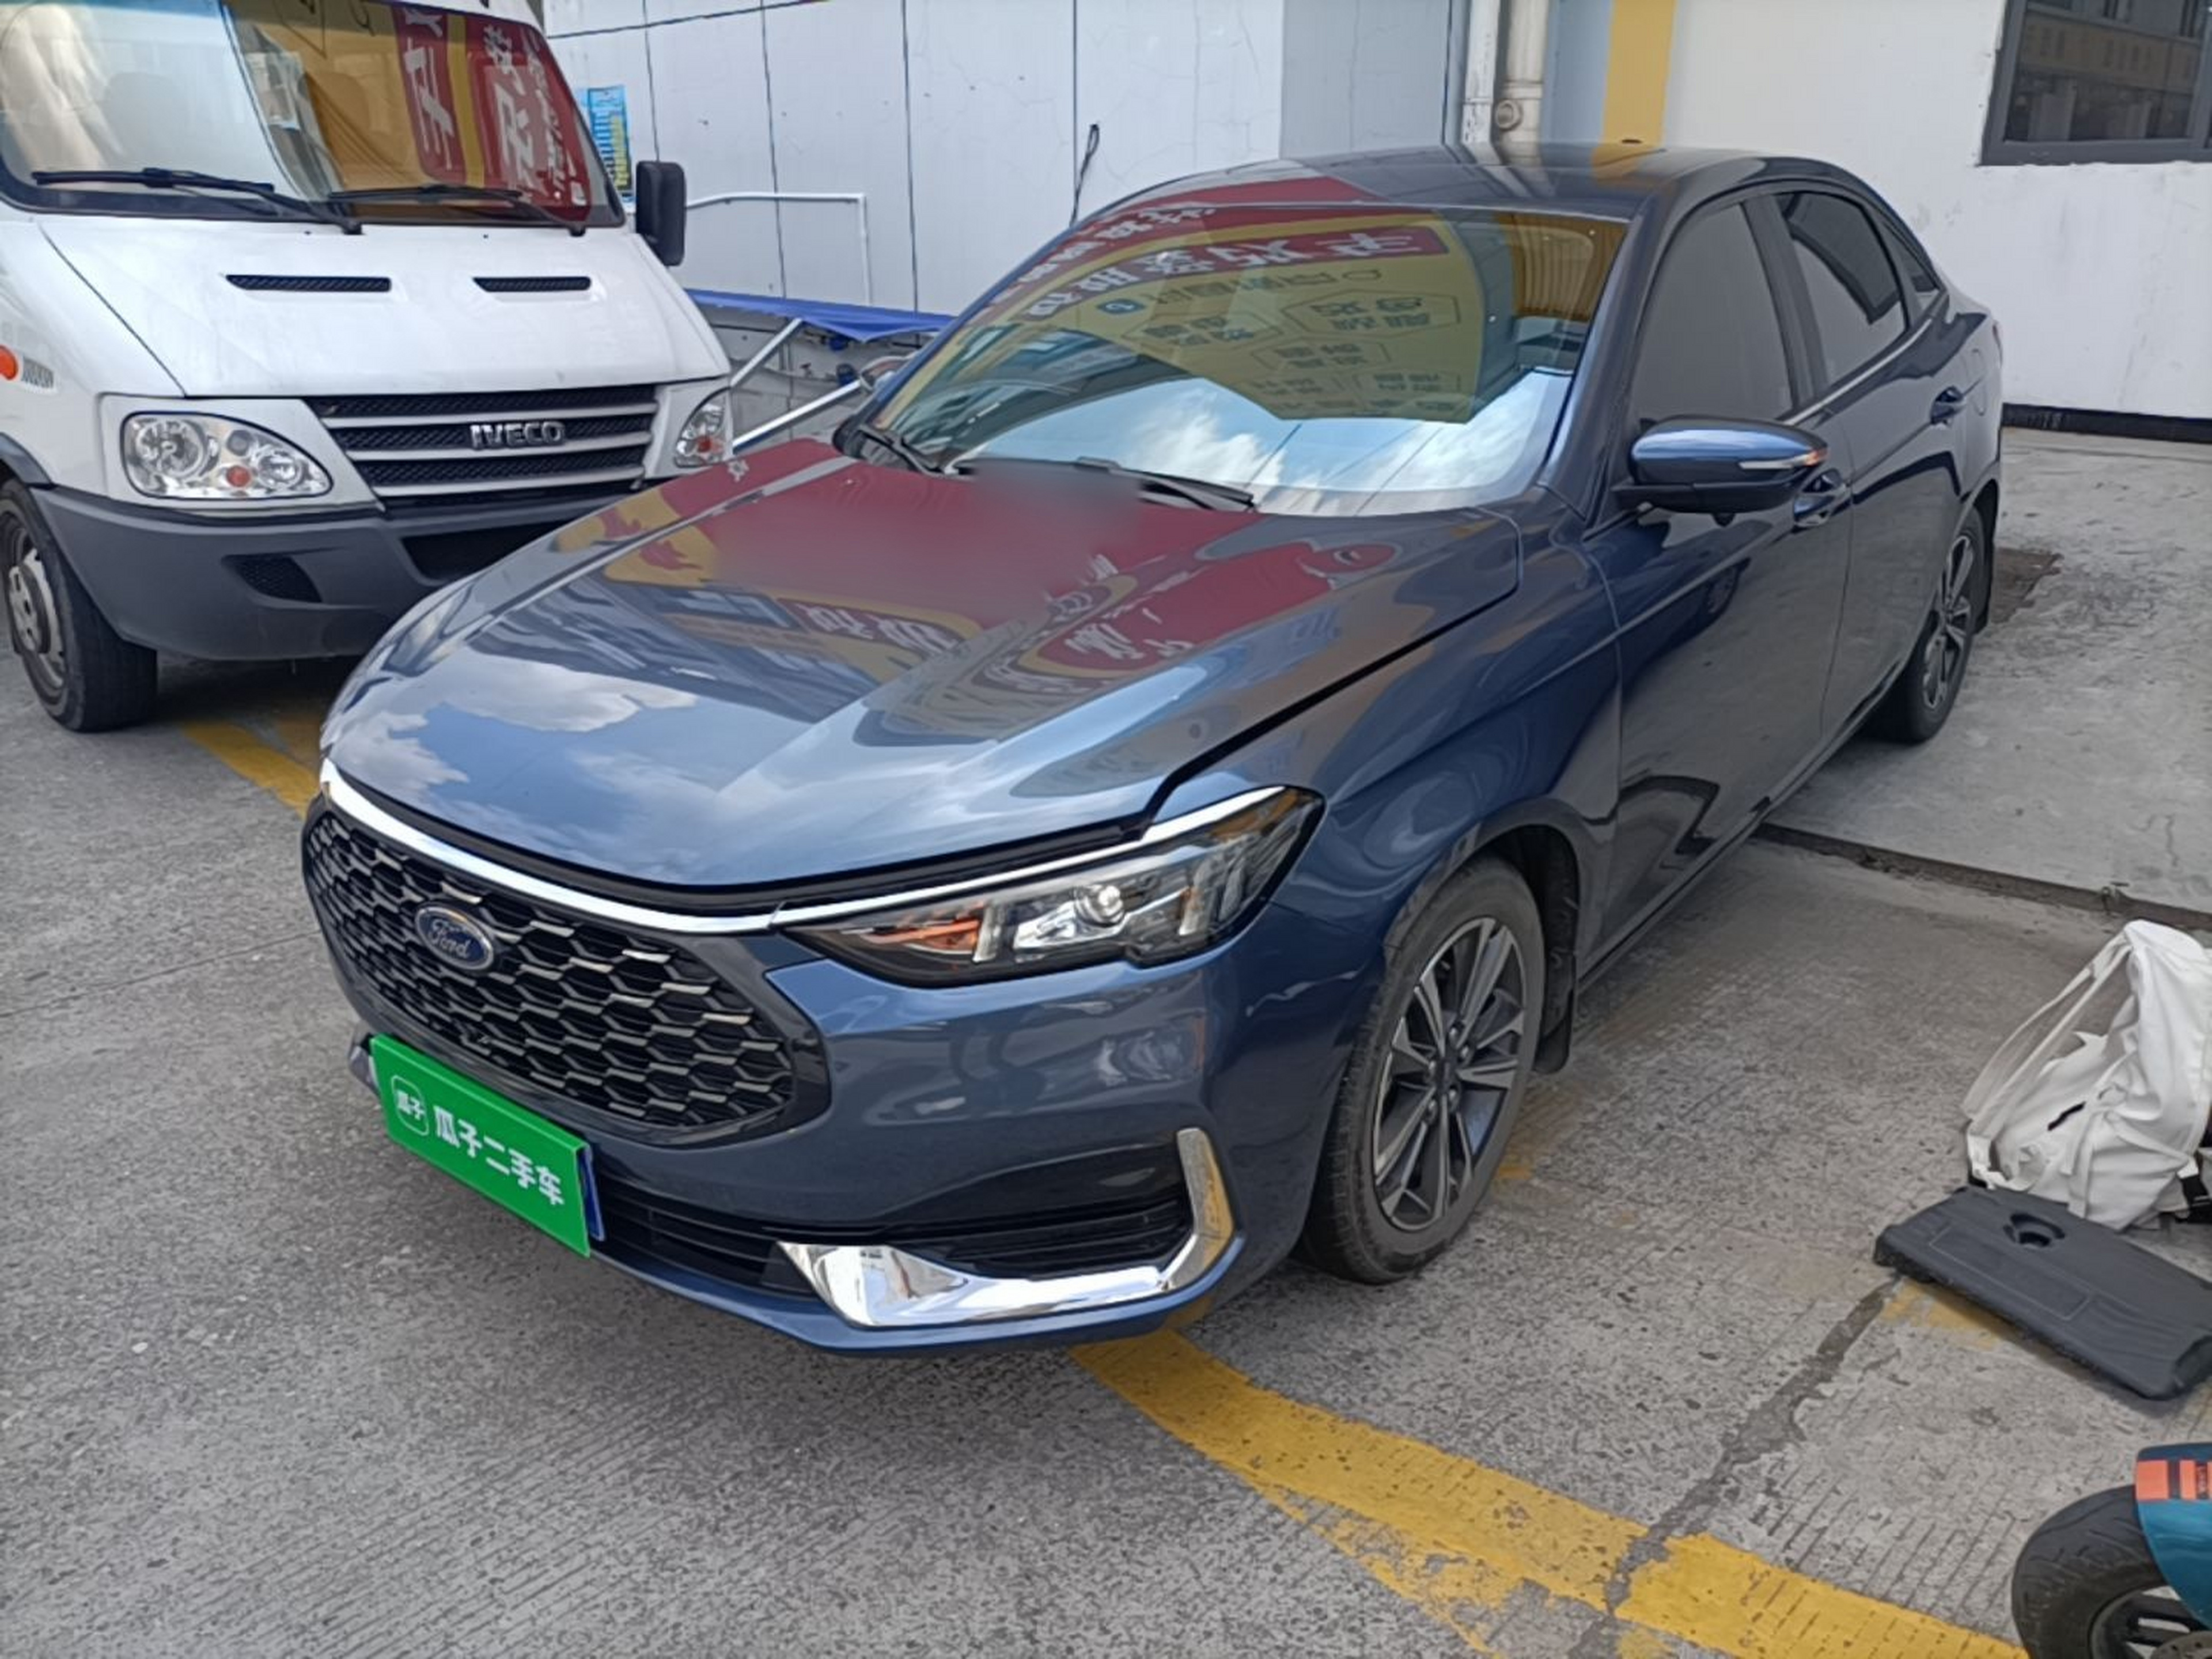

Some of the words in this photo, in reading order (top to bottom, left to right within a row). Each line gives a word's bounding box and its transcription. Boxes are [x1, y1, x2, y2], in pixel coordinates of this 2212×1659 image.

[469, 421, 566, 449] IVECO
[428, 918, 471, 961] Ford
[396, 1089, 426, 1119] 瓜子
[433, 1105, 565, 1206] 瓜子二手车
